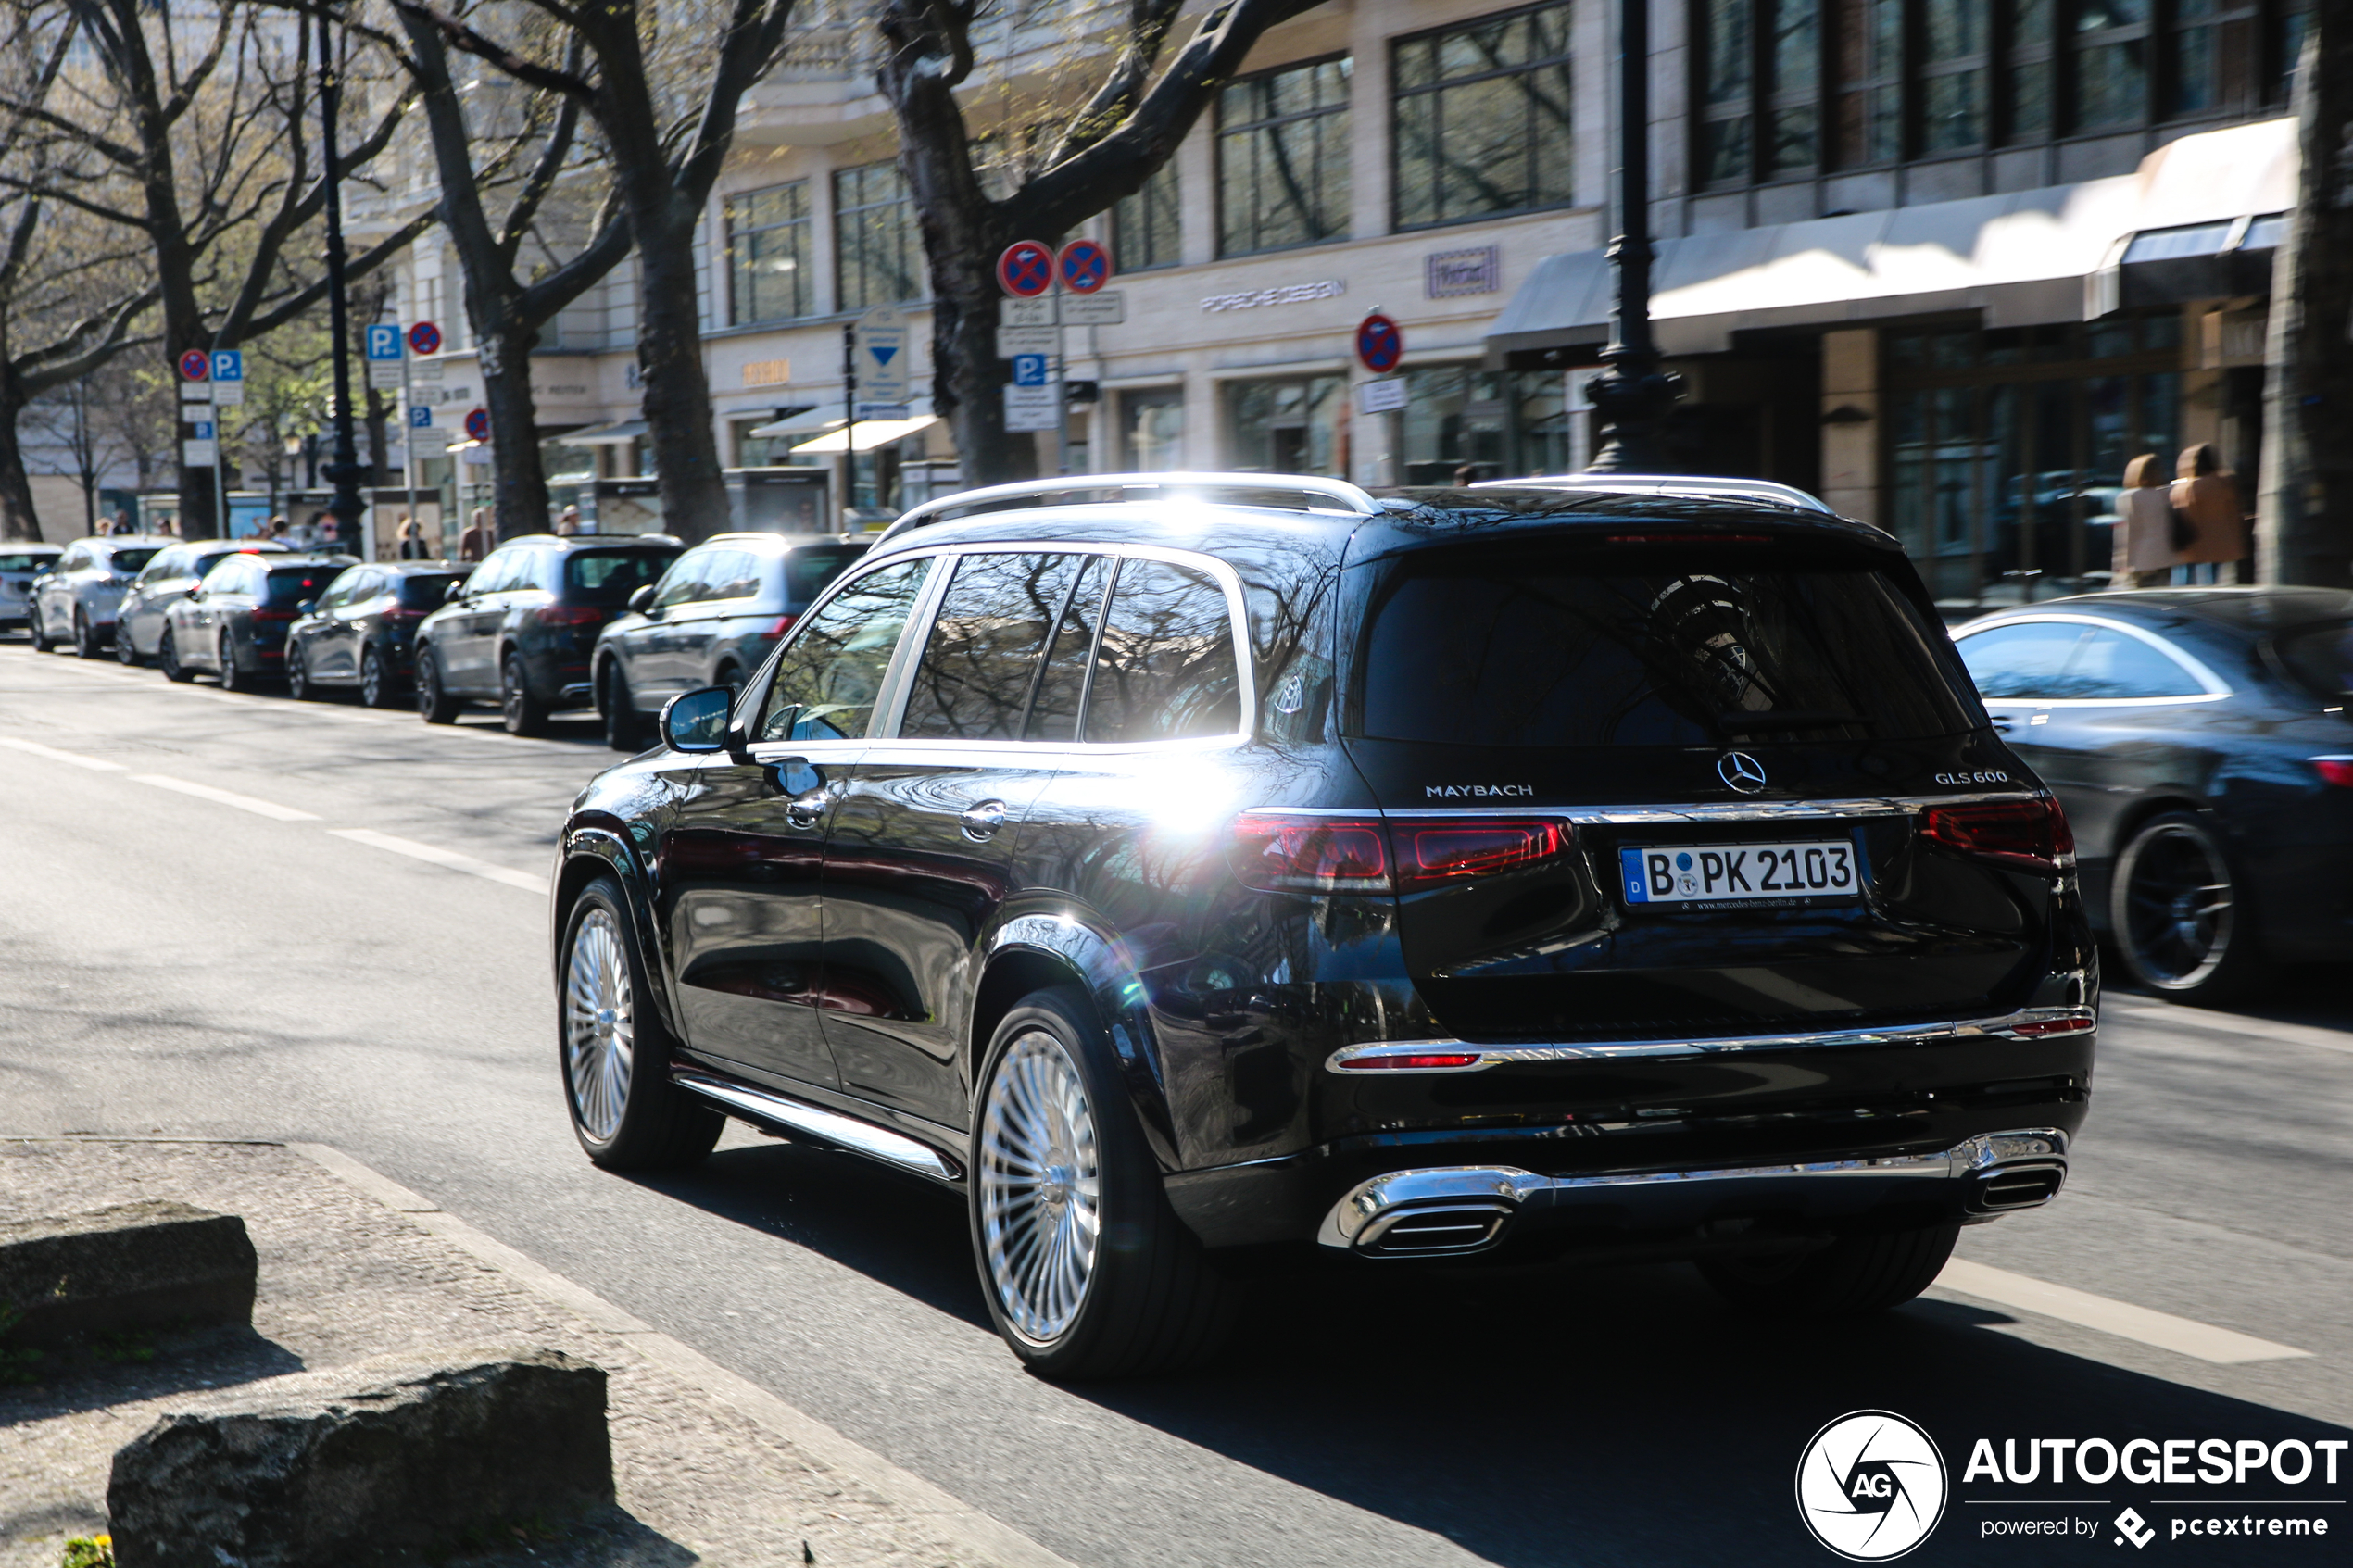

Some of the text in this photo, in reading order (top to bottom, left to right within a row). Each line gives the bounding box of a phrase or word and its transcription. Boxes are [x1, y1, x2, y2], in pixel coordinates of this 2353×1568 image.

[371, 329, 393, 357] P
[215, 354, 233, 378] P
[1935, 771, 2008, 784] GLS 600
[1425, 784, 1534, 797] MAYBACH
[1647, 847, 1851, 896] B PK 2103
[1631, 881, 1641, 894] D
